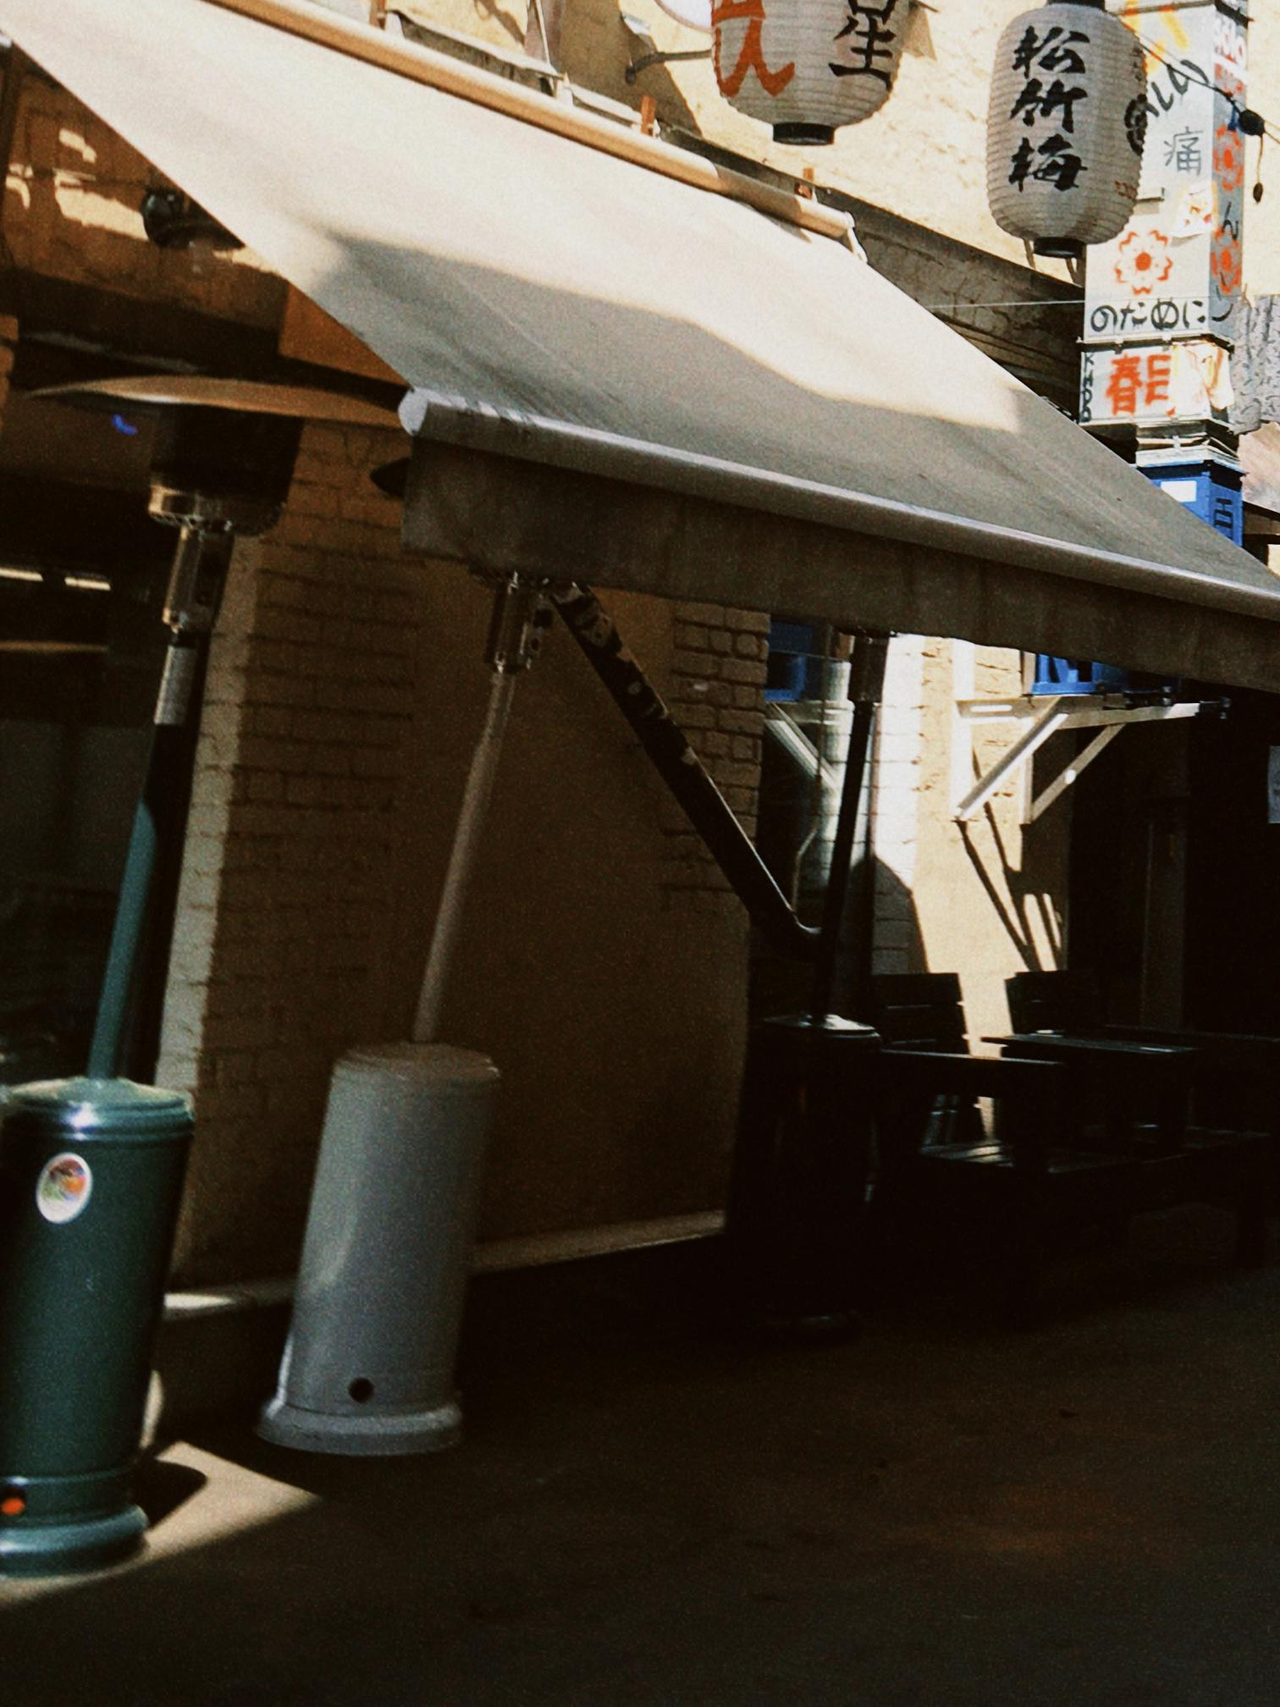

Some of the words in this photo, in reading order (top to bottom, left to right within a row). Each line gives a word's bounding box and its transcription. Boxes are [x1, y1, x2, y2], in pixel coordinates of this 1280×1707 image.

[1008, 24, 1093, 193] 松竹梅
[1162, 125, 1204, 176] 痛
[1091, 299, 1207, 334] のために
